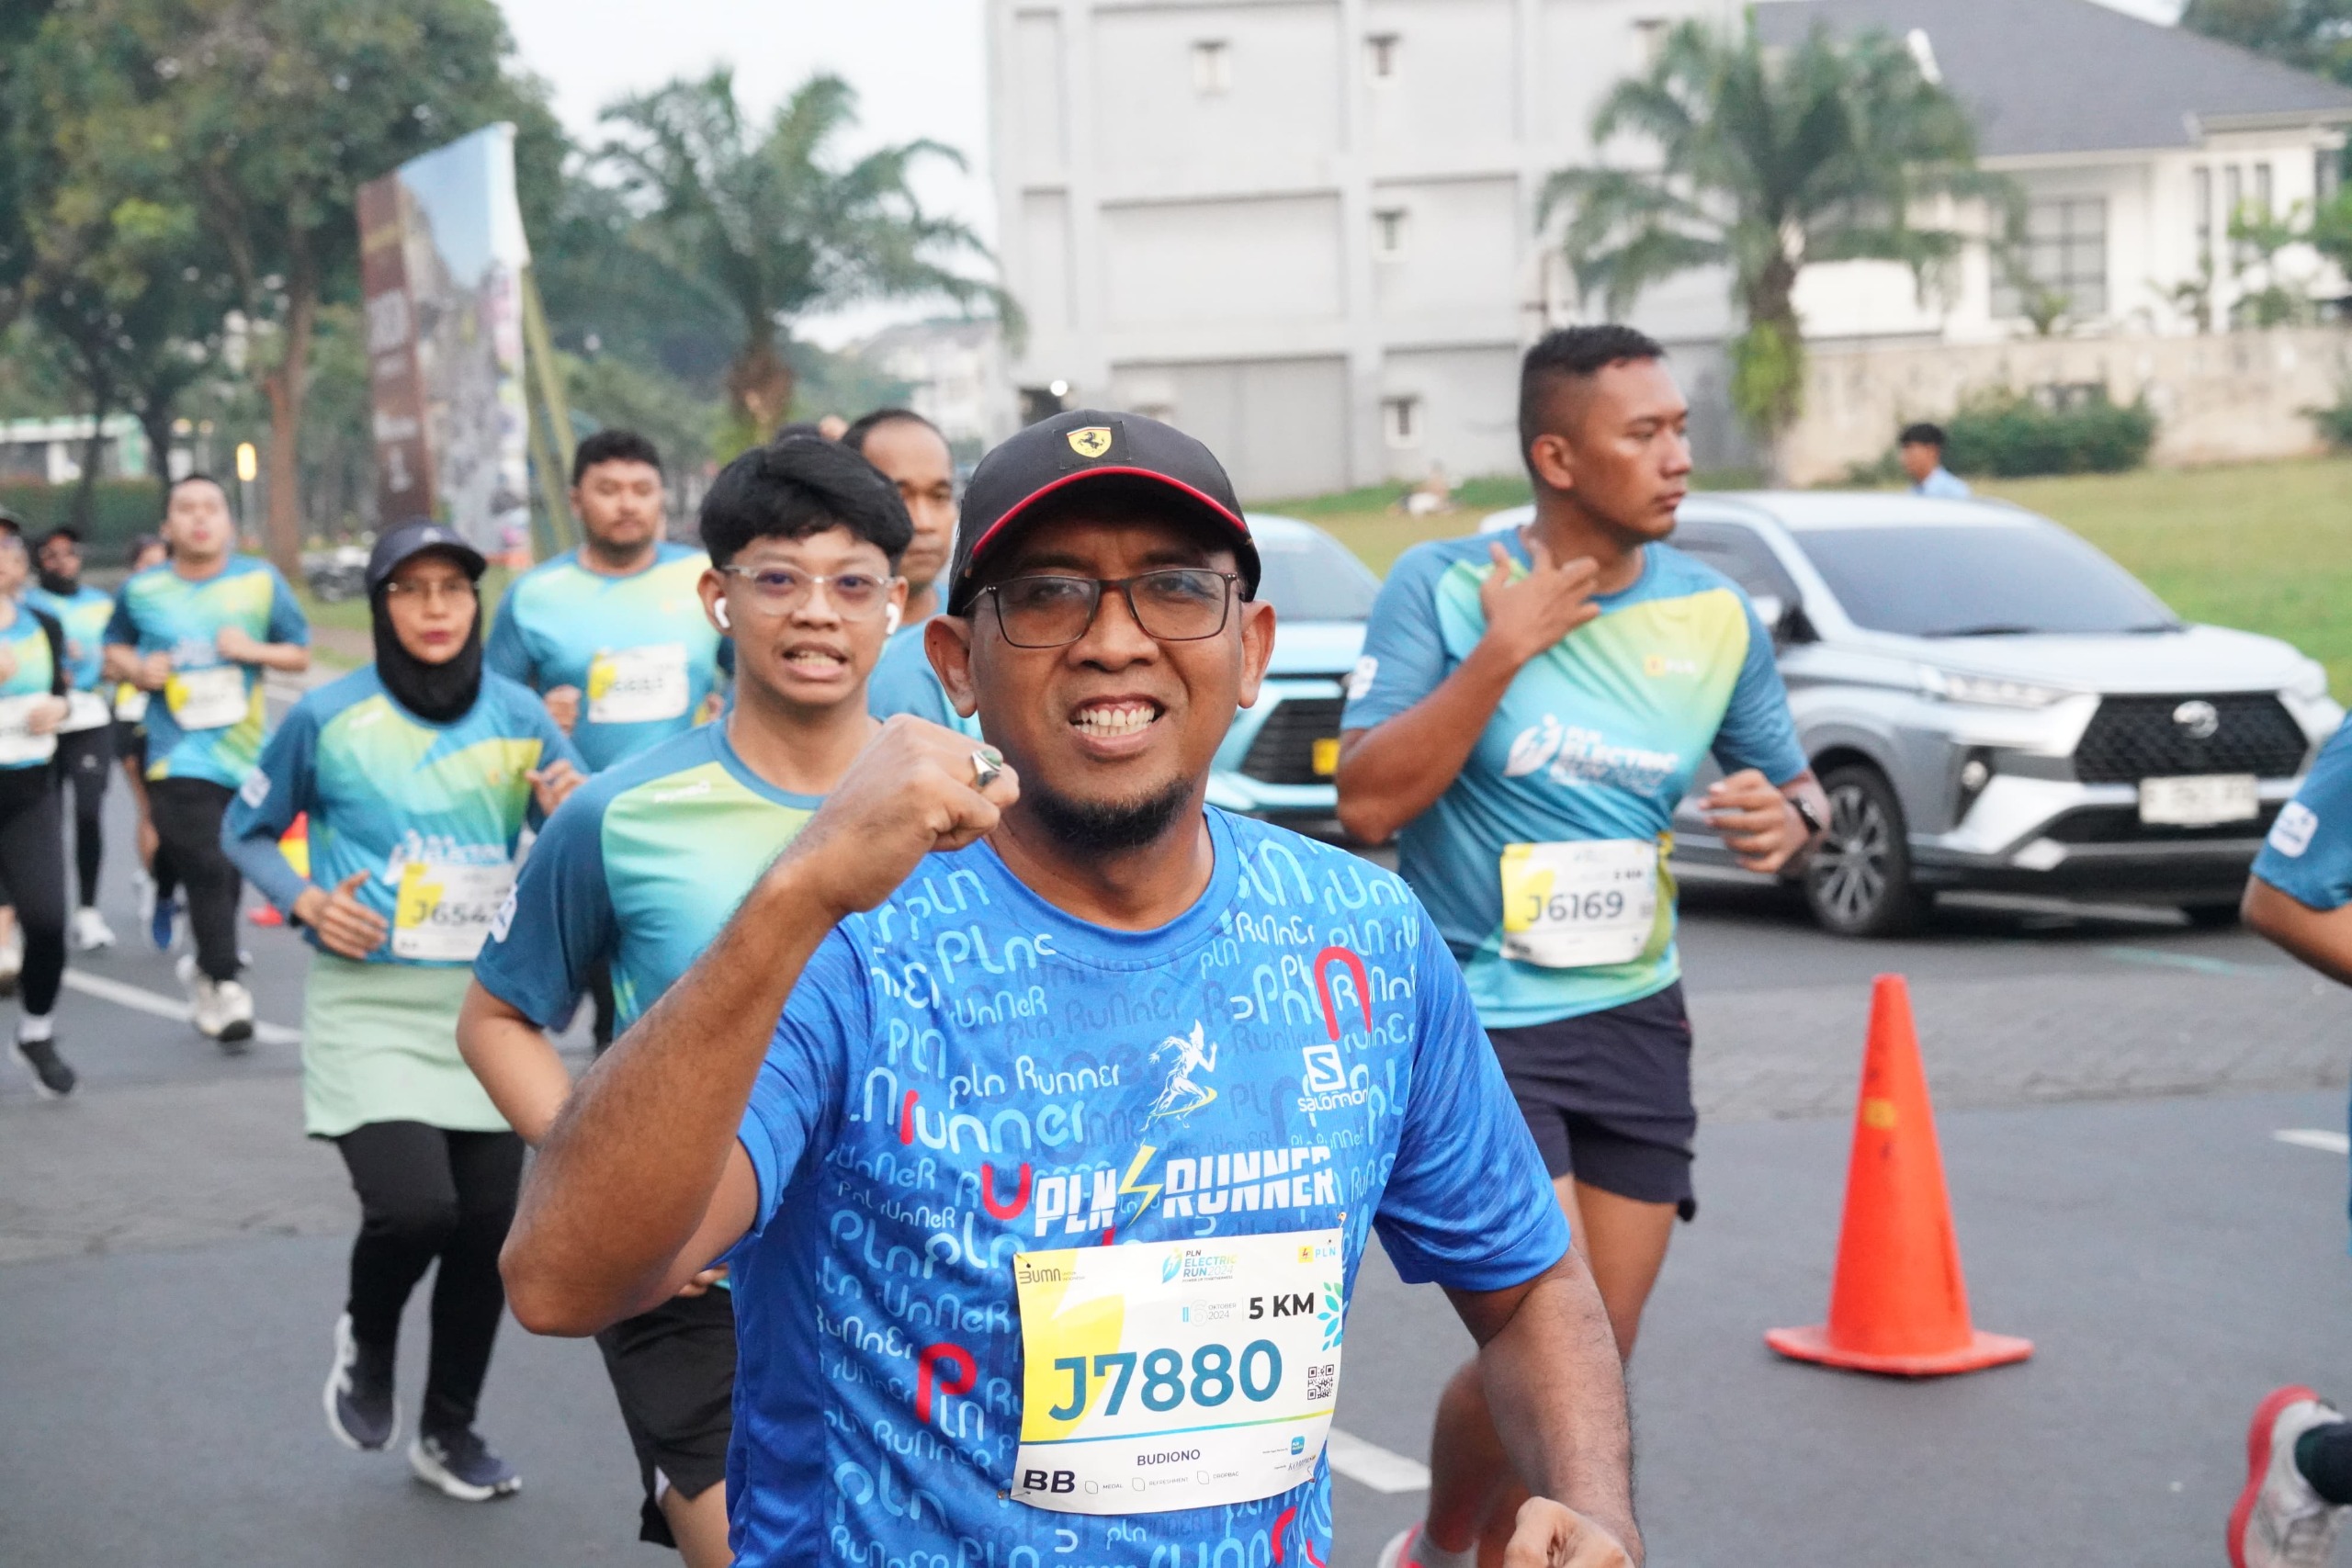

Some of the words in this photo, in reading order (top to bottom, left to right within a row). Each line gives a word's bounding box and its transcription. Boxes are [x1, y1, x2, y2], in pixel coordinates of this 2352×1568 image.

[1526, 890, 1624, 922] J6169
[1035, 1168, 1117, 1237] PLN
[1162, 1145, 1336, 1219] RUNNER
[1184, 1254, 1238, 1268] ELECTRIC
[1185, 1249, 1202, 1258] PLN
[1315, 1247, 1336, 1258] PLN
[1208, 1303, 1237, 1311] OKTOBER
[1249, 1297, 1263, 1320] 5
[1272, 1292, 1314, 1318] KM
[1208, 1311, 1230, 1320] 2024
[1048, 1338, 1283, 1421] J7880
[1137, 1449, 1201, 1467] BUDIONO
[1023, 1469, 1076, 1494] BB
